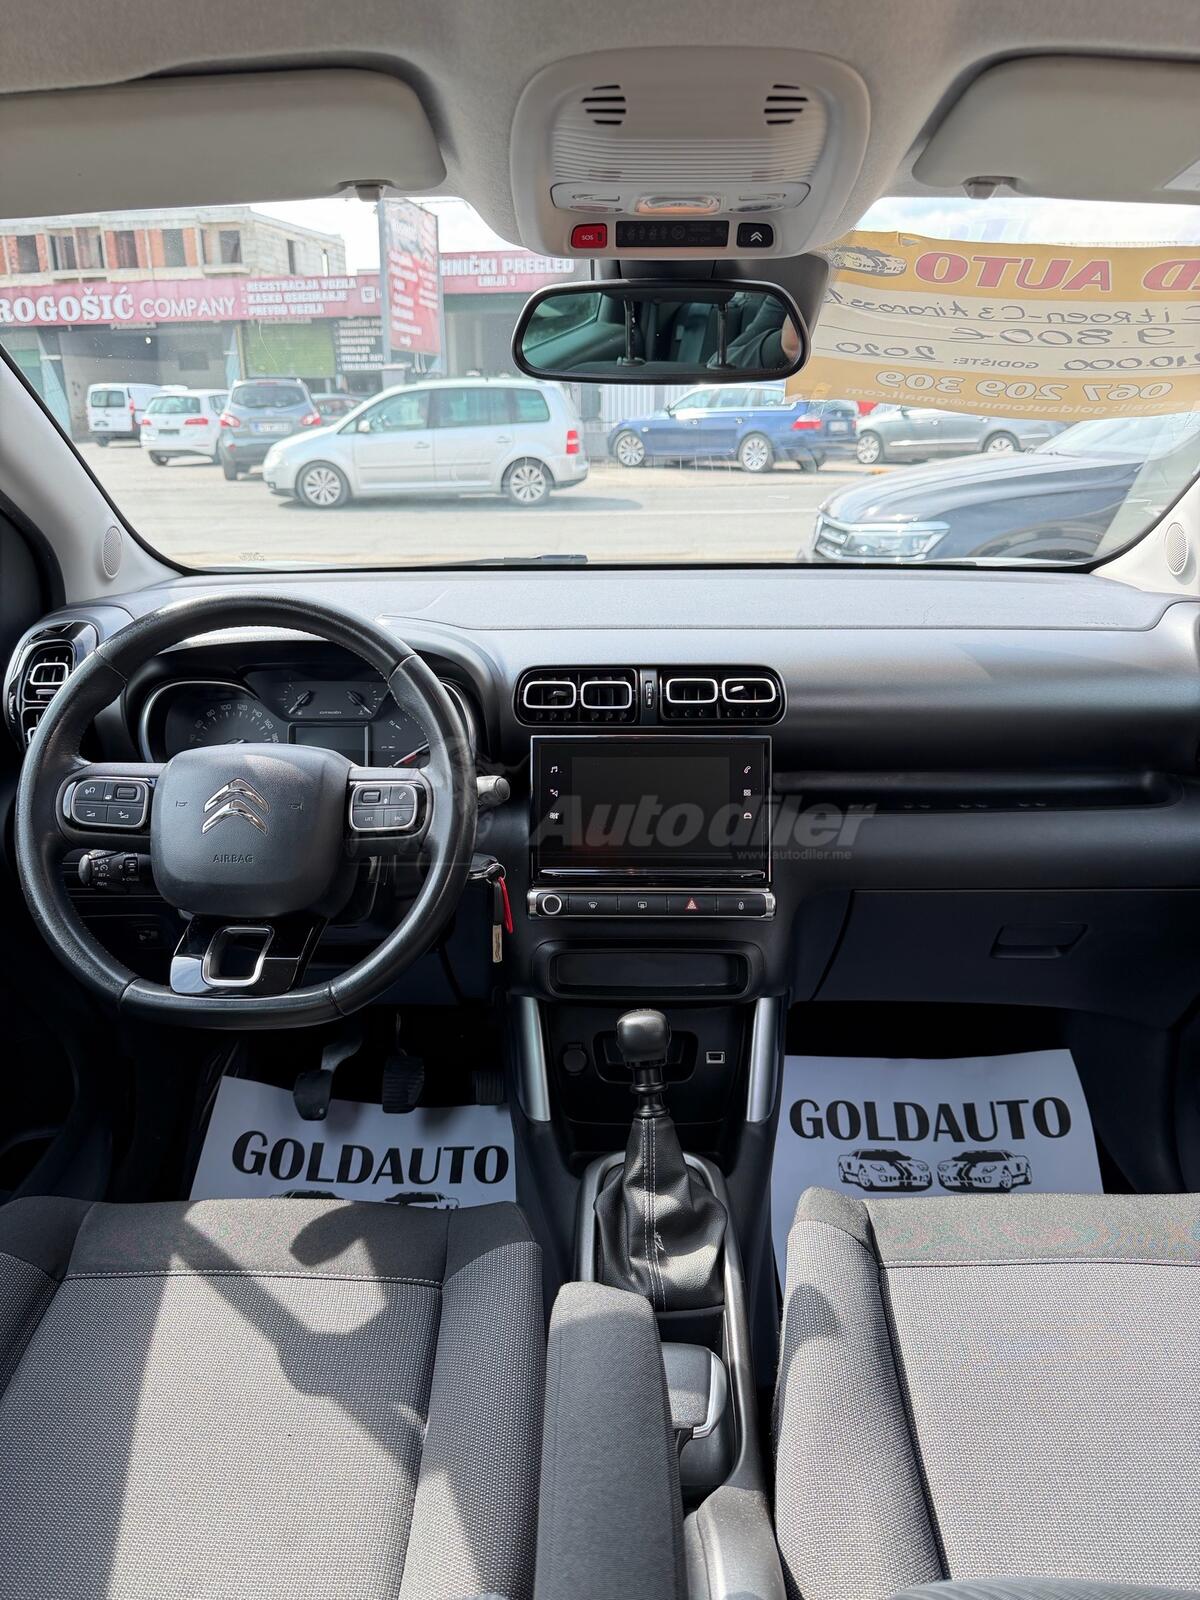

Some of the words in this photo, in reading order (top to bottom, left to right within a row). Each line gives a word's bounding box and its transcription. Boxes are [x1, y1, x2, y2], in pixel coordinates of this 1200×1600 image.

[140, 296, 236, 319] COMPANY
[212, 854, 254, 864] AIRBAG
[788, 1096, 1072, 1143] GOLDAUTO
[231, 1130, 509, 1185] GOLDAUTO
